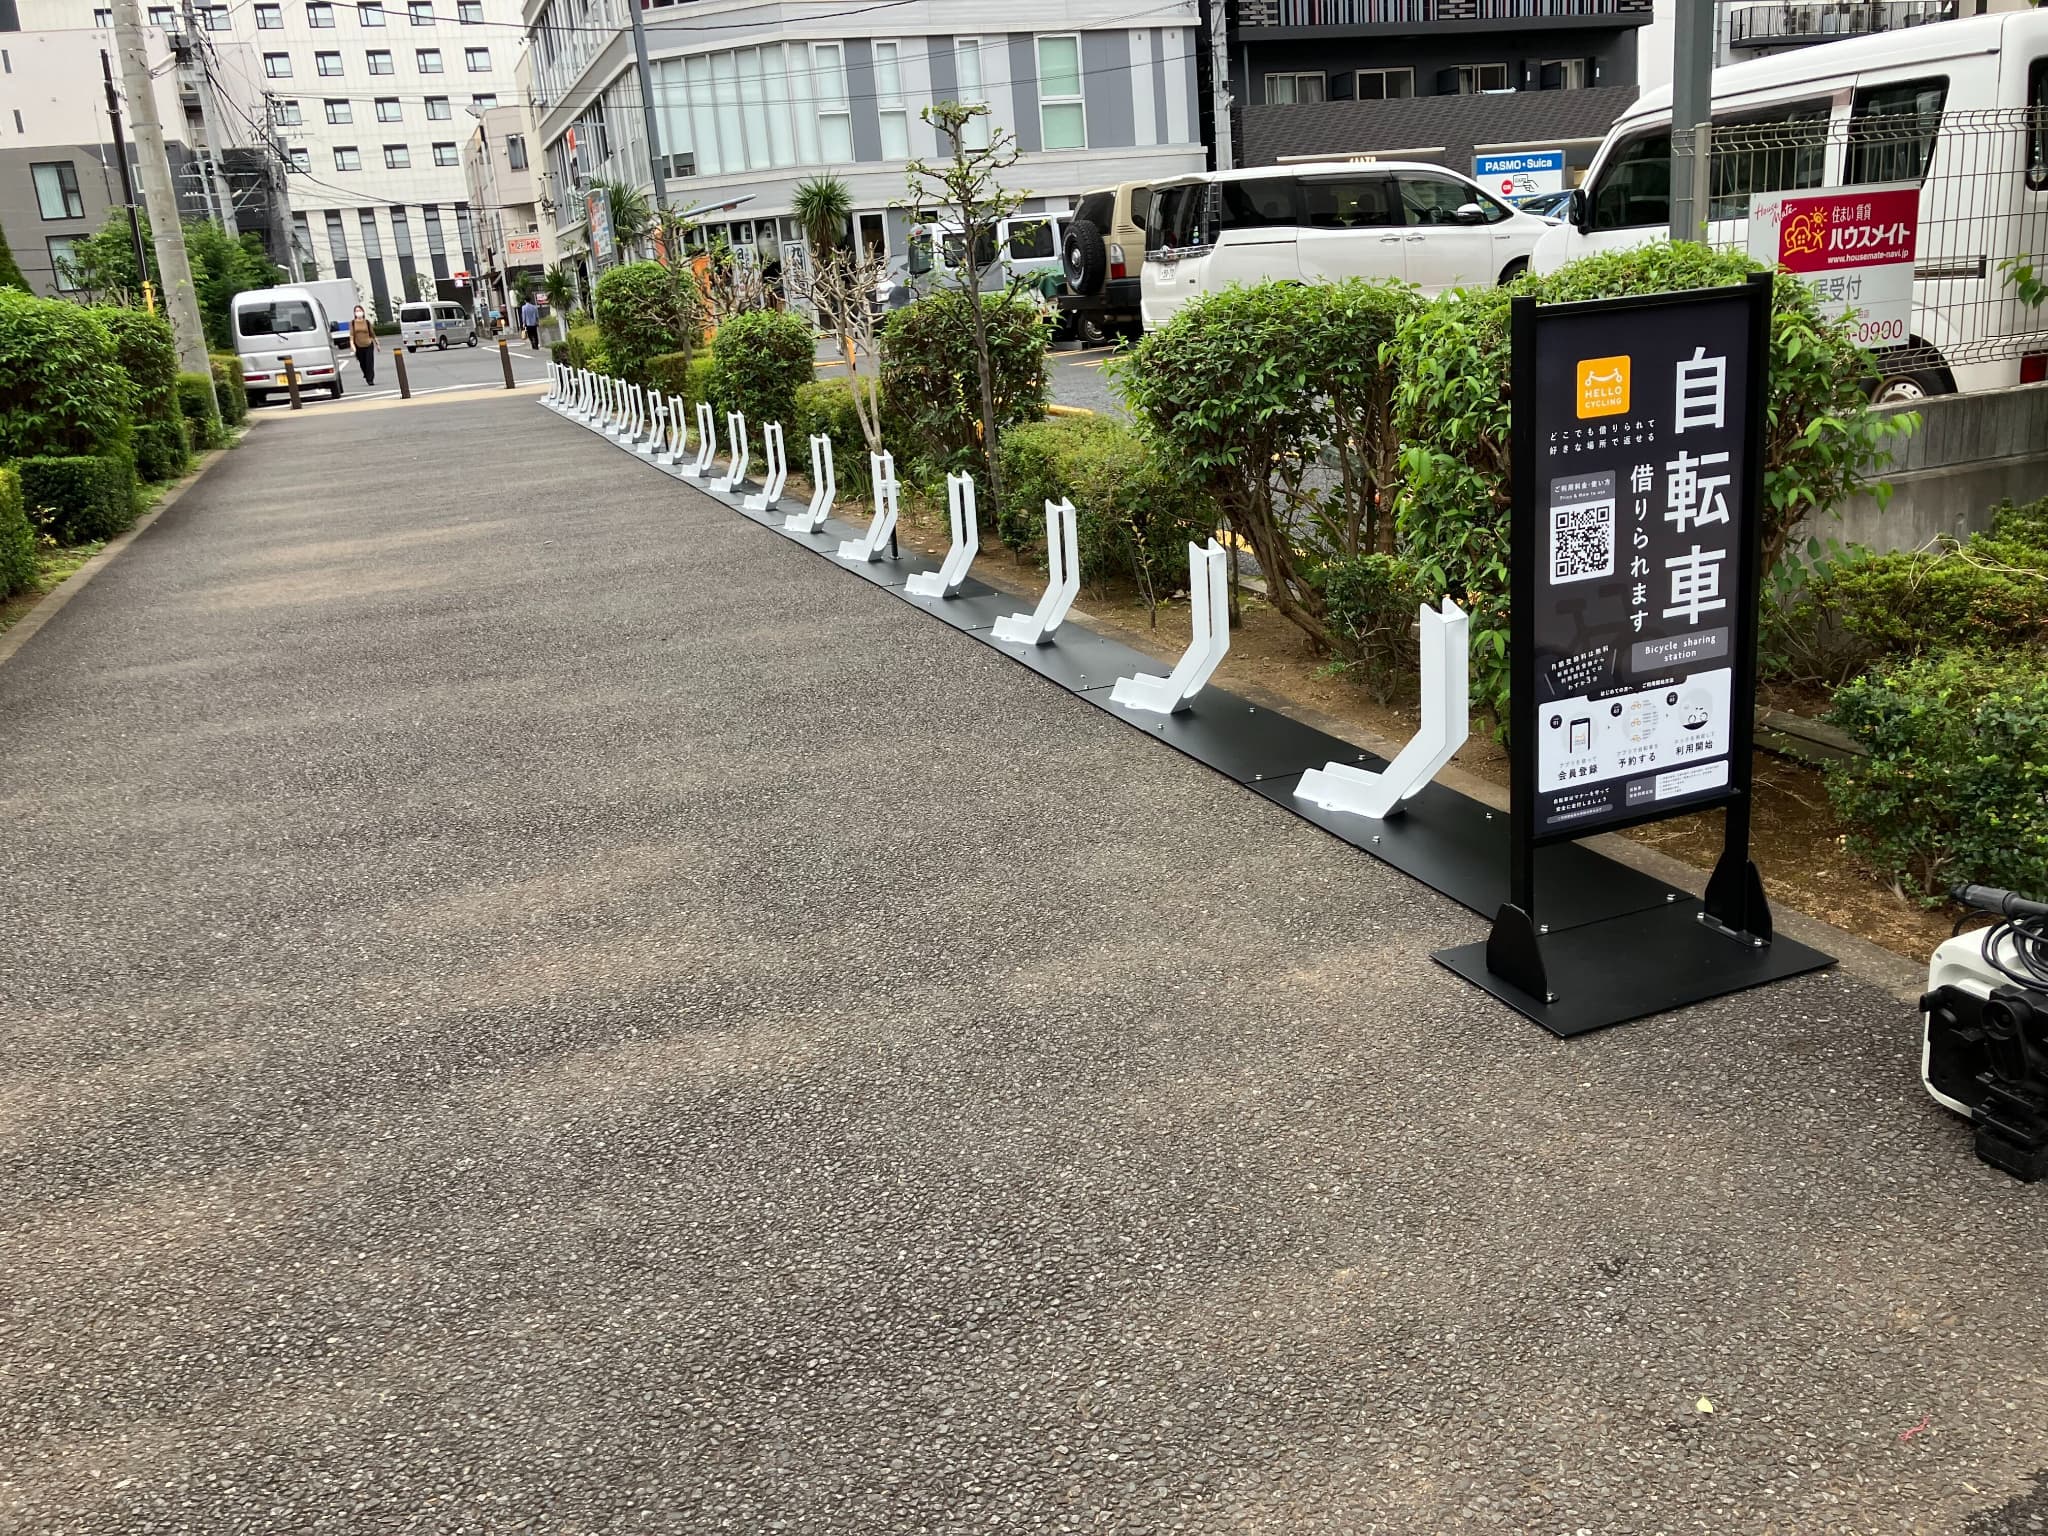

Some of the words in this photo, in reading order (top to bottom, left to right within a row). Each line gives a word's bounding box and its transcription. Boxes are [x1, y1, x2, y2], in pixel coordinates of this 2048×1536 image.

[1828, 222, 1911, 251] ハウスメイト
[1827, 249, 1909, 264] www.housemate-navi.jp
[1797, 274, 1862, 304] 居受付
[1584, 386, 1622, 399] HELLO
[1584, 397, 1622, 409] CYCLING
[1550, 419, 1656, 442] どこでも借りられて
[1549, 433, 1655, 456] 好きな場所で返せる
[1663, 346, 1731, 625] 自転車
[1630, 463, 1654, 633] 借りられます
[1645, 640, 1678, 655] Bicycle
[1683, 633, 1716, 649] sharing
[1664, 649, 1697, 662] station
[1676, 740, 1713, 756] 利用開始
[1618, 752, 1656, 769] 予約する
[1558, 764, 1598, 781] 会員登録
